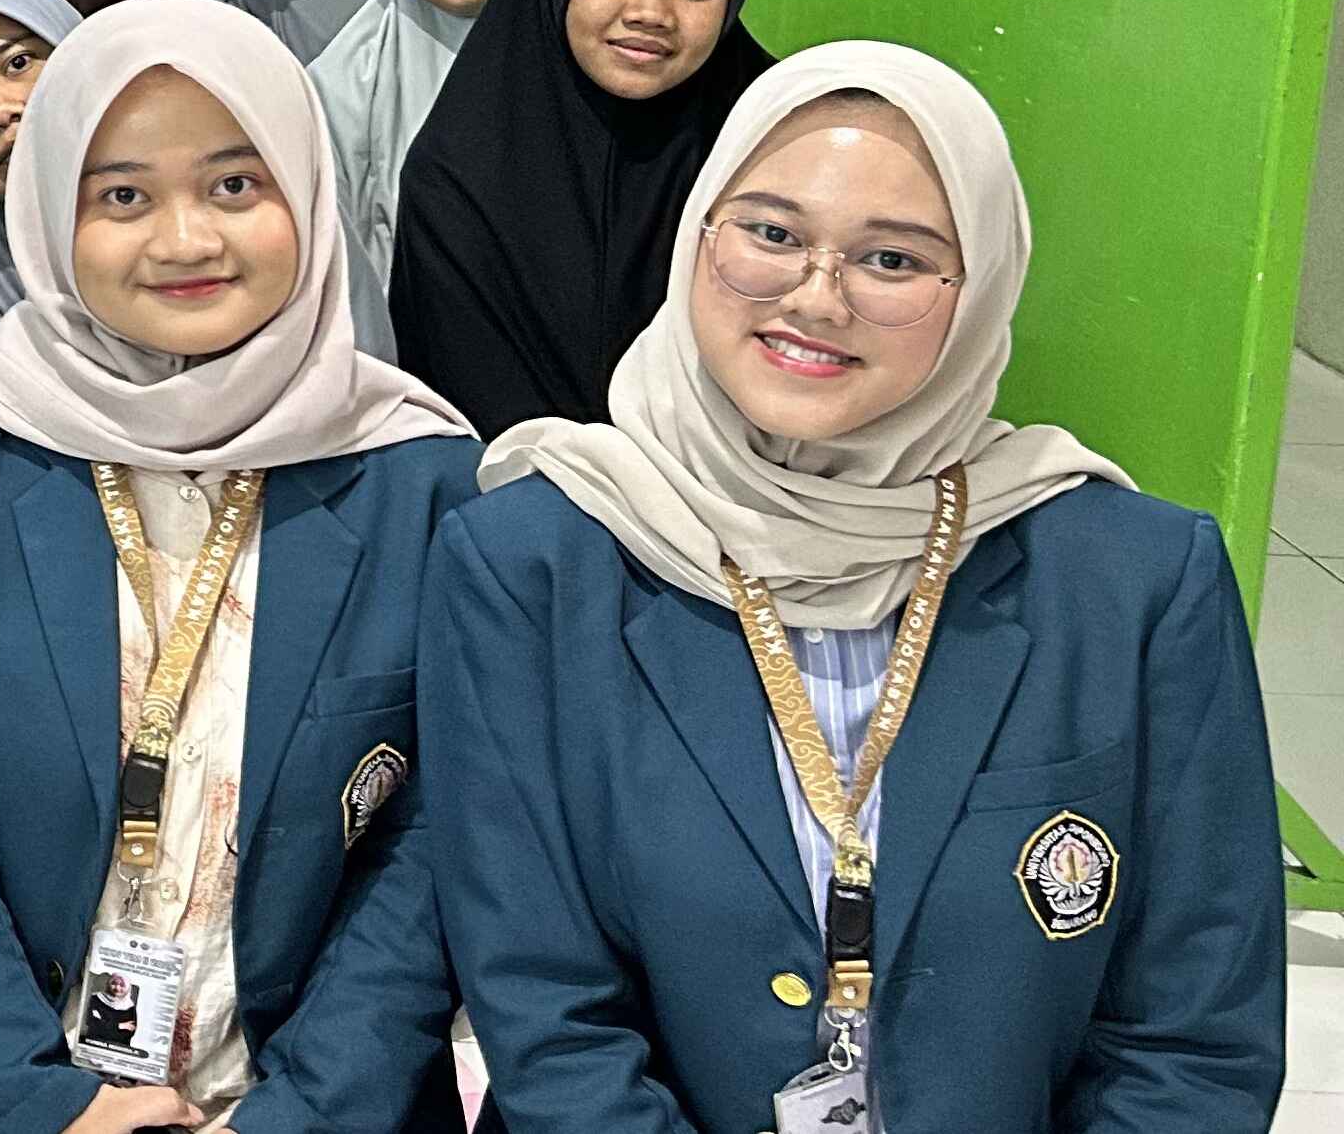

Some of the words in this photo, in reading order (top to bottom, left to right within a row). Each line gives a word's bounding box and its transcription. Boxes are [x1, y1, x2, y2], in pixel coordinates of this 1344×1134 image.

[97, 465, 120, 501] TIM
[112, 507, 134, 550] KKN
[924, 478, 956, 582] DEMAKAN
[740, 570, 764, 601] TI
[752, 607, 788, 655] KKN
[878, 597, 929, 732] MOJOLABAN
